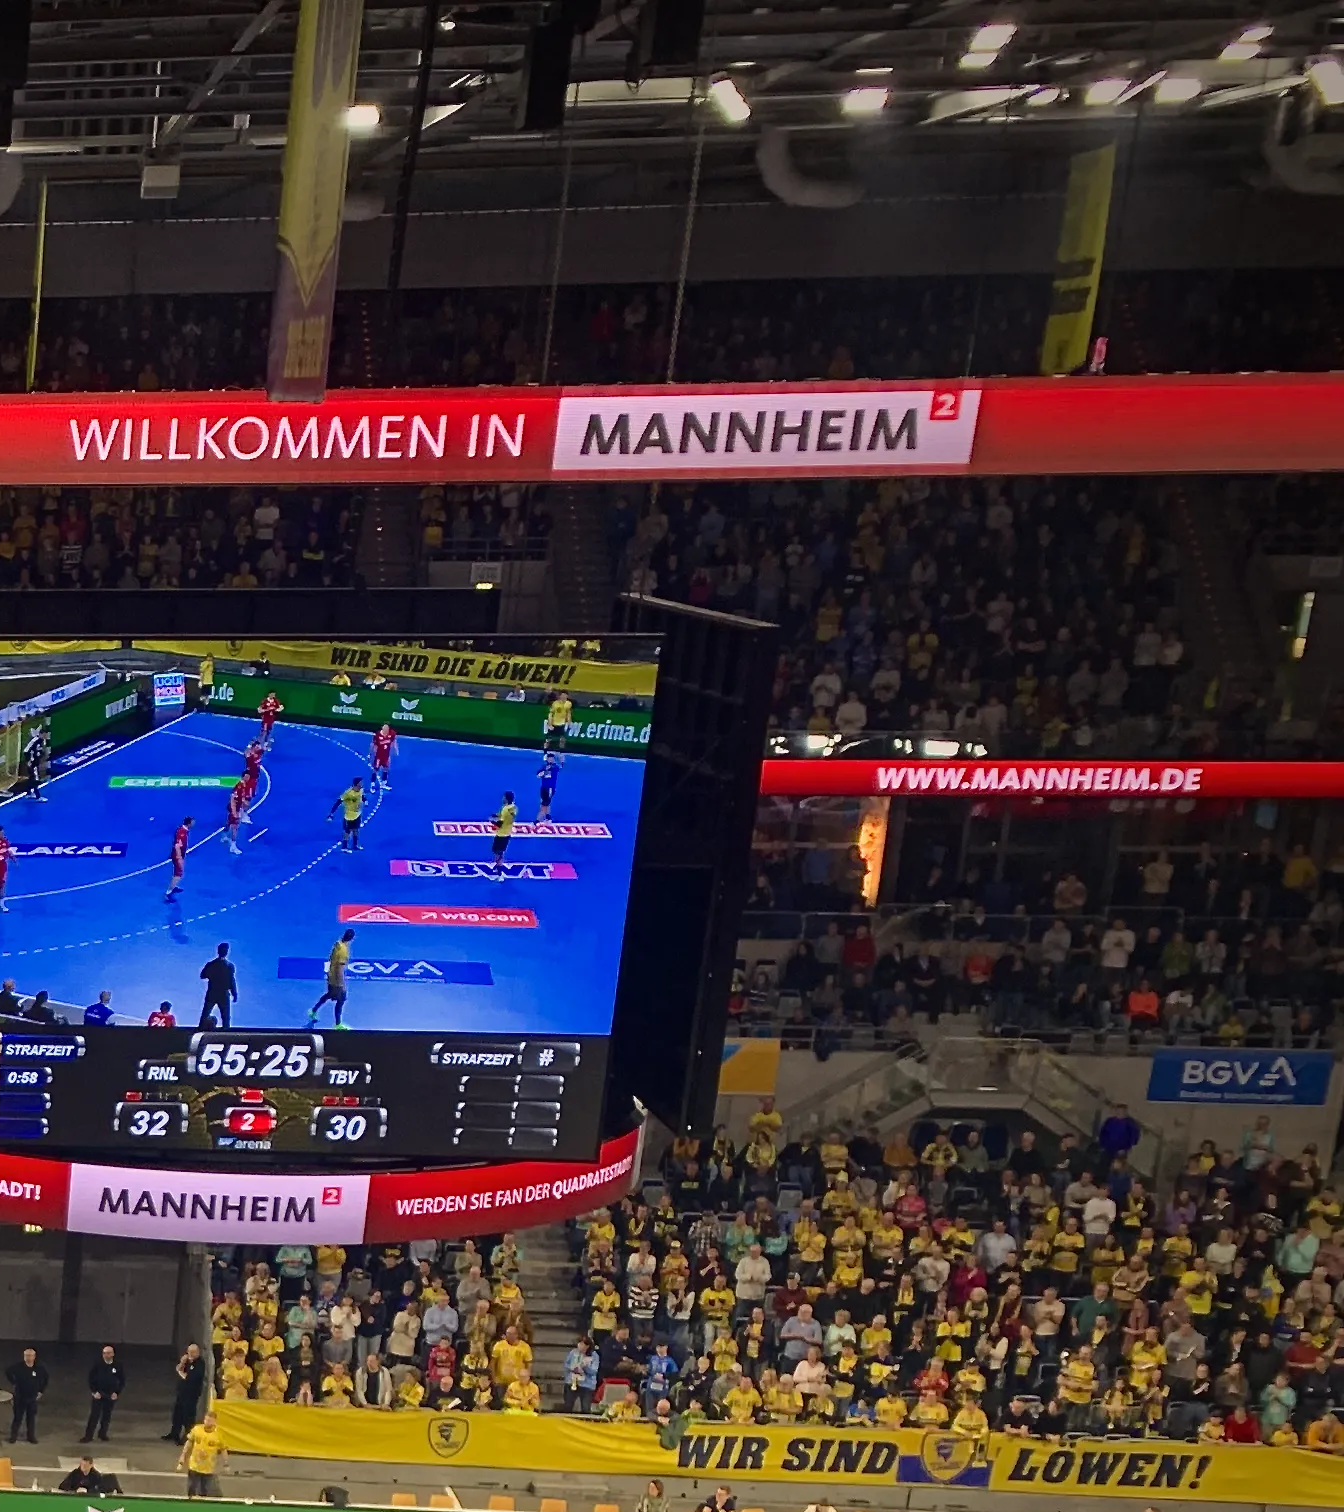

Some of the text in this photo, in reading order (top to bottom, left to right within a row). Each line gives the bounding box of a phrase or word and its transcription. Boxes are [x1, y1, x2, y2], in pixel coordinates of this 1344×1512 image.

[69, 413, 525, 461] WILLKOMMEN IN
[579, 408, 919, 456] MANNHEIM
[330, 648, 577, 685] WIR SIND DIE LÖWEN!
[877, 767, 1203, 792] WWW.MANNHEIM.DE
[5, 1044, 75, 1058] STRAFZEIT
[198, 1044, 311, 1077] 55:25
[442, 1053, 515, 1066] STRAFZEIT
[147, 1066, 179, 1081] RNL
[328, 1070, 359, 1084] TBV
[1181, 1060, 1258, 1086] BGV
[130, 1110, 170, 1137] 32
[240, 1113, 255, 1130] 2
[325, 1115, 367, 1141] 30
[98, 1187, 316, 1223] MANNHEIM
[396, 1195, 468, 1216] WERDEN
[469, 1192, 493, 1209] SIE
[495, 1188, 523, 1207] FAN
[525, 1183, 551, 1202] DER
[676, 1434, 1213, 1490] WIR SIND LÖWEN!
